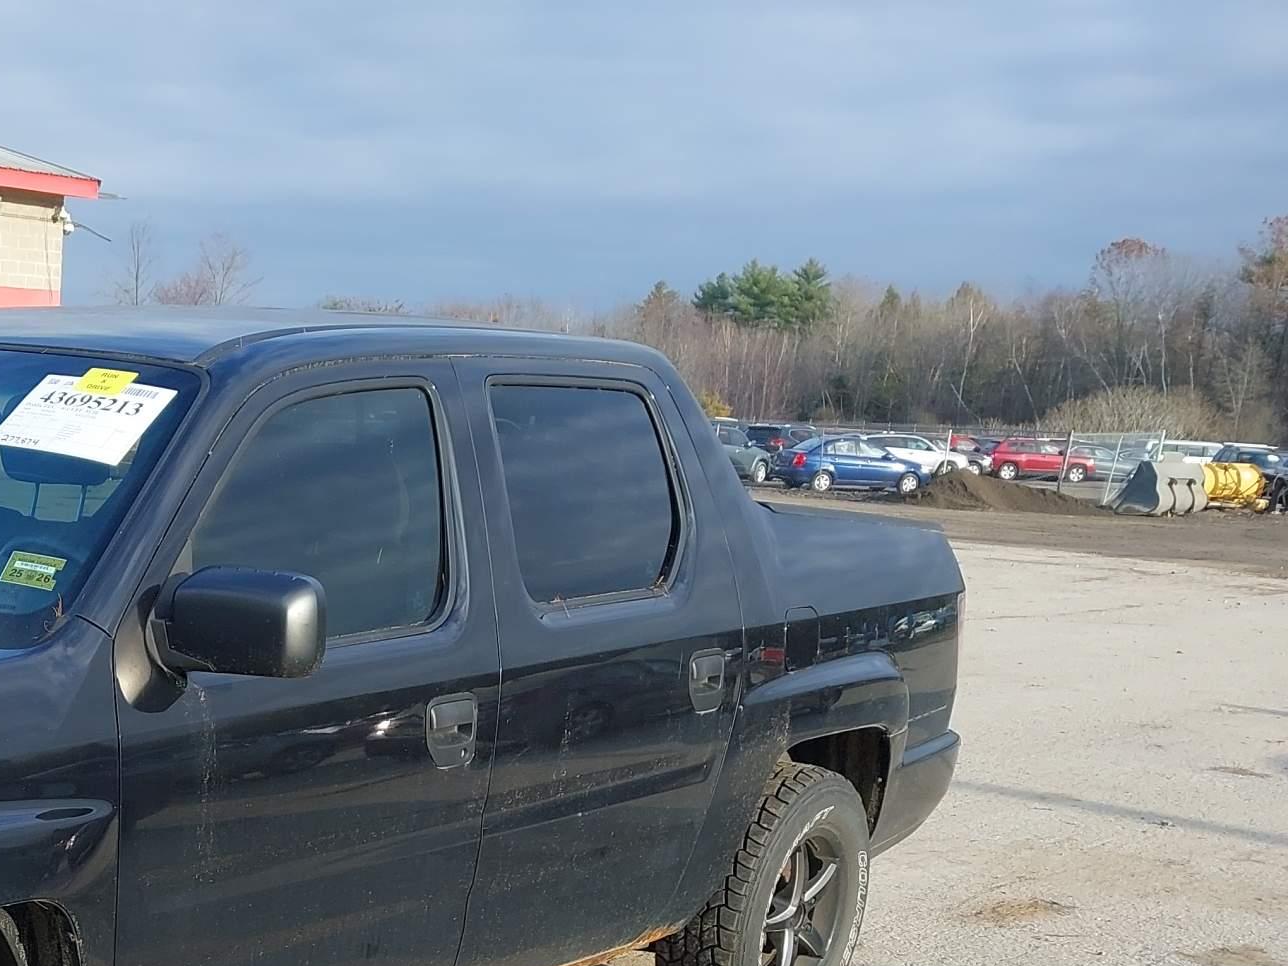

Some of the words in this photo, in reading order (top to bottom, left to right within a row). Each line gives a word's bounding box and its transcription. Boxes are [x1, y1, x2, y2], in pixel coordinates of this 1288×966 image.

[40, 390, 145, 416] 43695213
[8, 568, 24, 578] 25
[35, 573, 52, 583] 26
